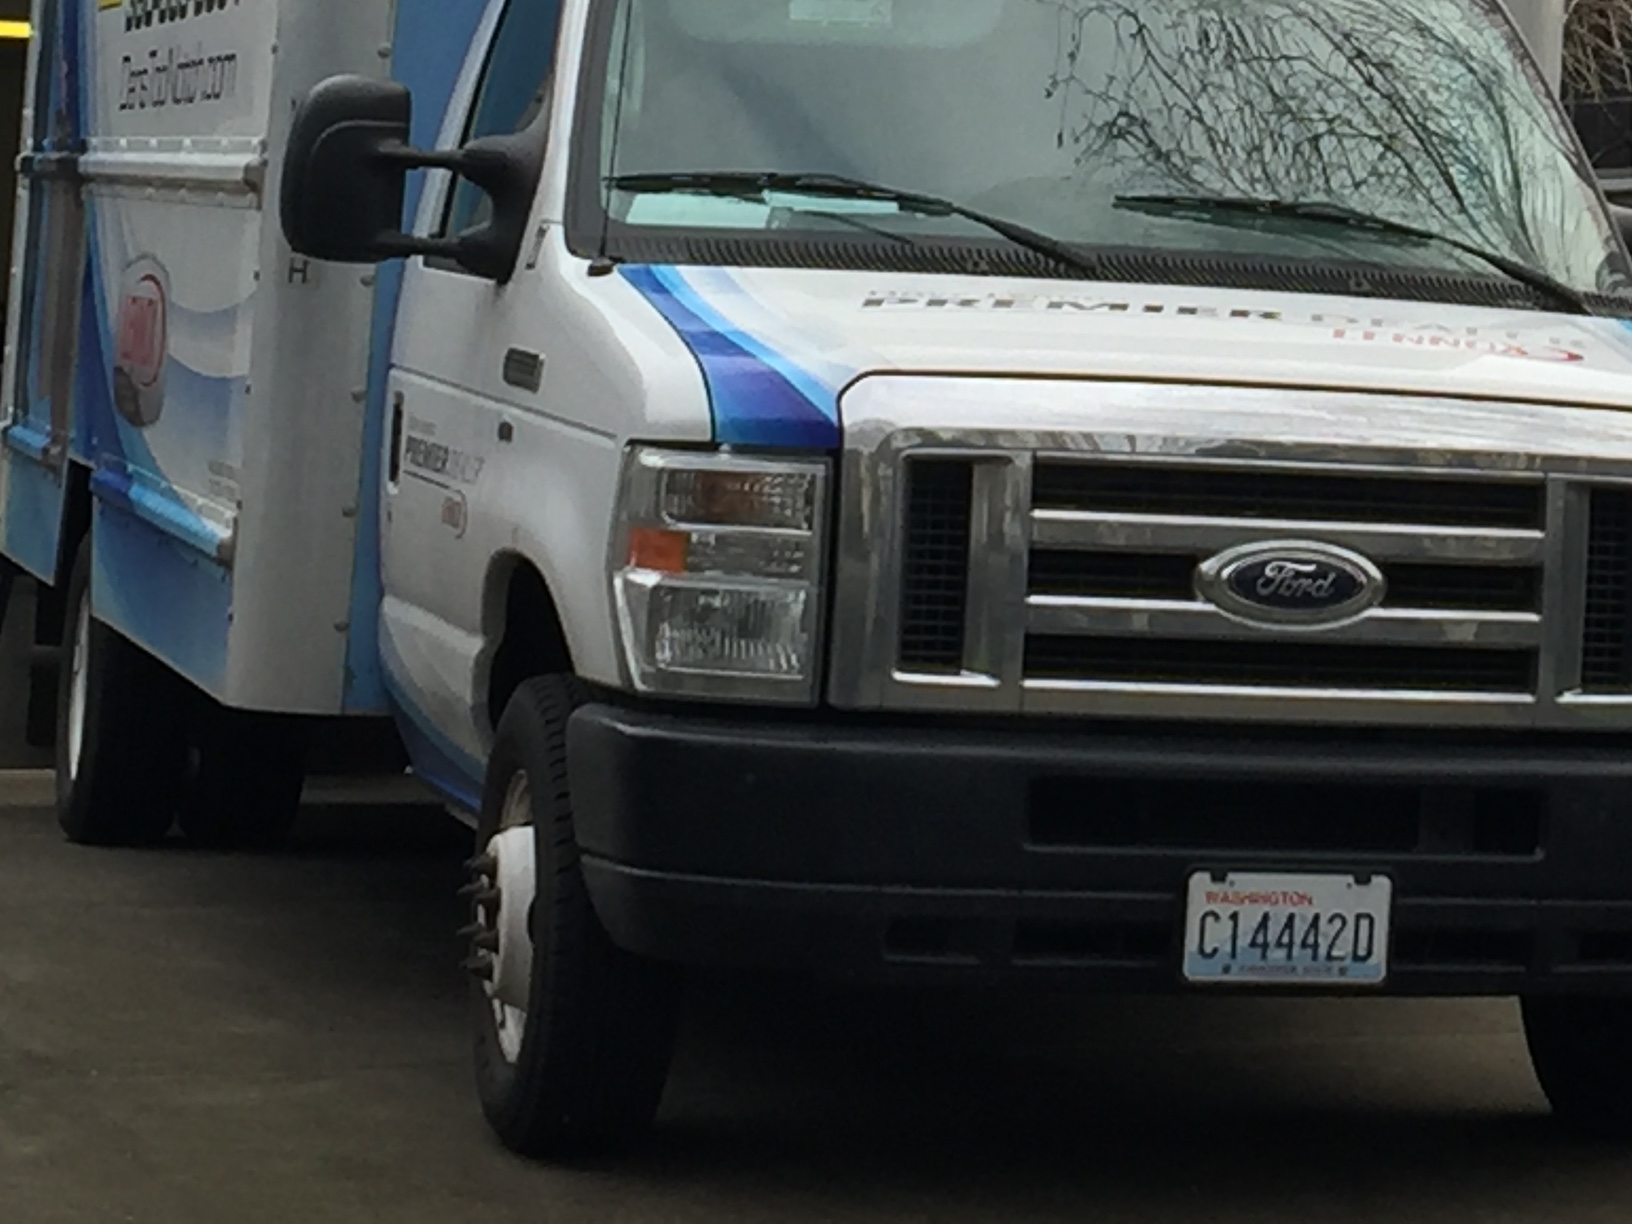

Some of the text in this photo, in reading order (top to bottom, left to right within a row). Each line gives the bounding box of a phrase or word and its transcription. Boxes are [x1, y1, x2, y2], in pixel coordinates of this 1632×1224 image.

[862, 297, 1281, 321] PREMIER
[1255, 559, 1337, 598] Ford
[1205, 890, 1314, 907] WASHINGTON
[1198, 909, 1376, 964] C14442D
